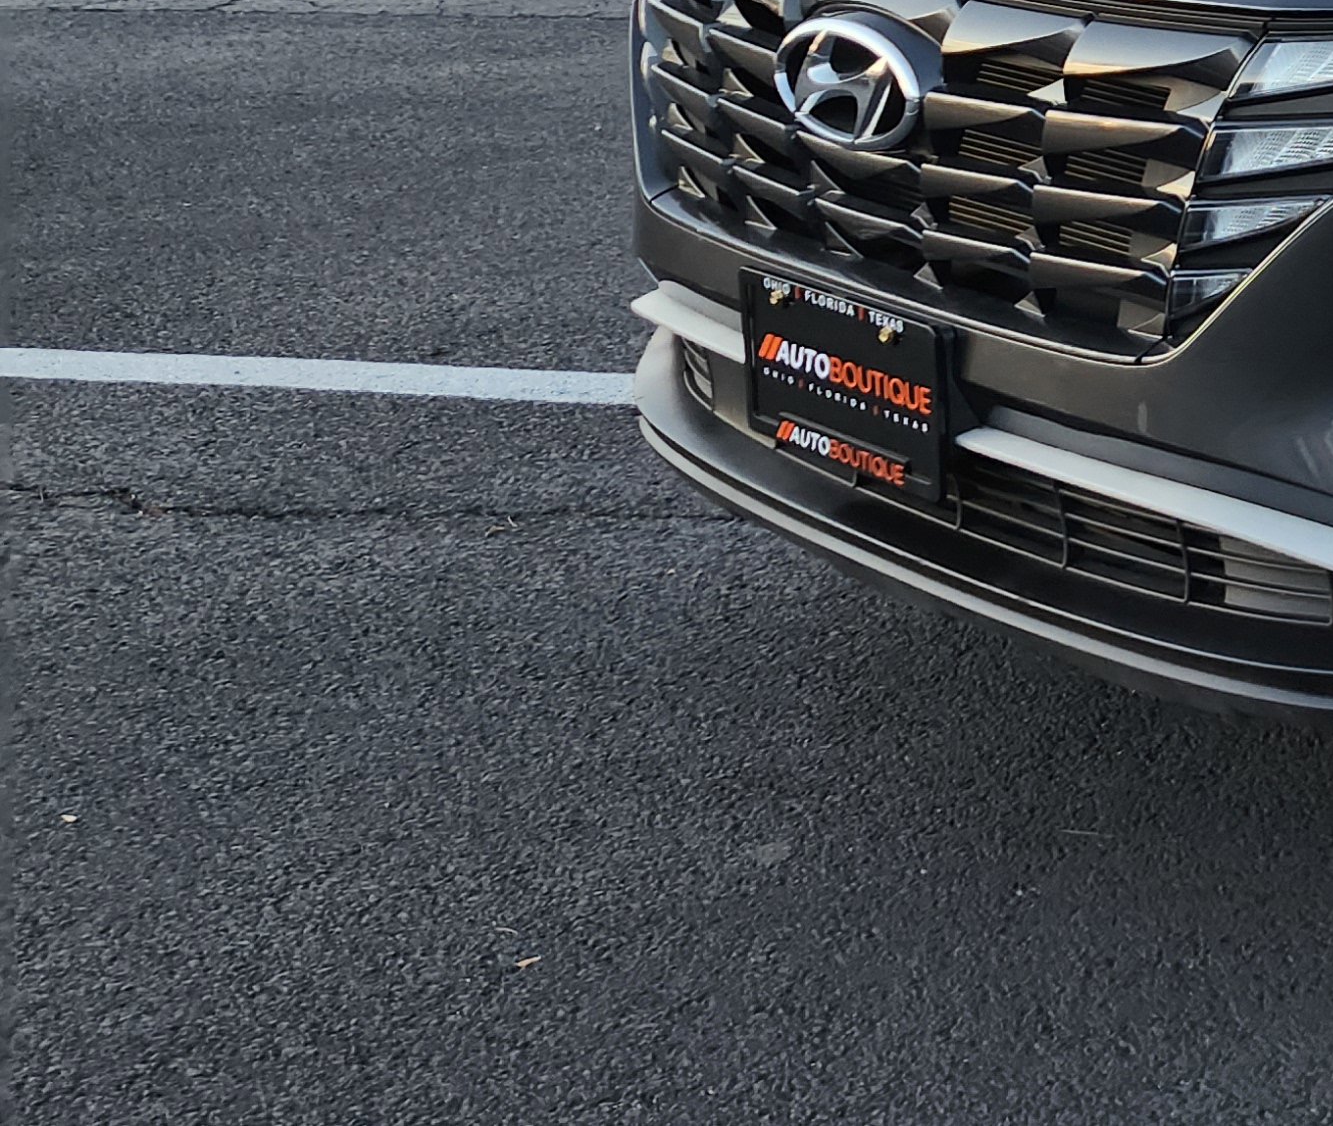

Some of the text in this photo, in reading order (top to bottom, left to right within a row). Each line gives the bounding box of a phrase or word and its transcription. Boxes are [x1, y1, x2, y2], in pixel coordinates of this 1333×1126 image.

[764, 277, 904, 333] OHIO FLORIDA TEXAS
[763, 367, 929, 433] OHIO FLORIDA TEXAS
